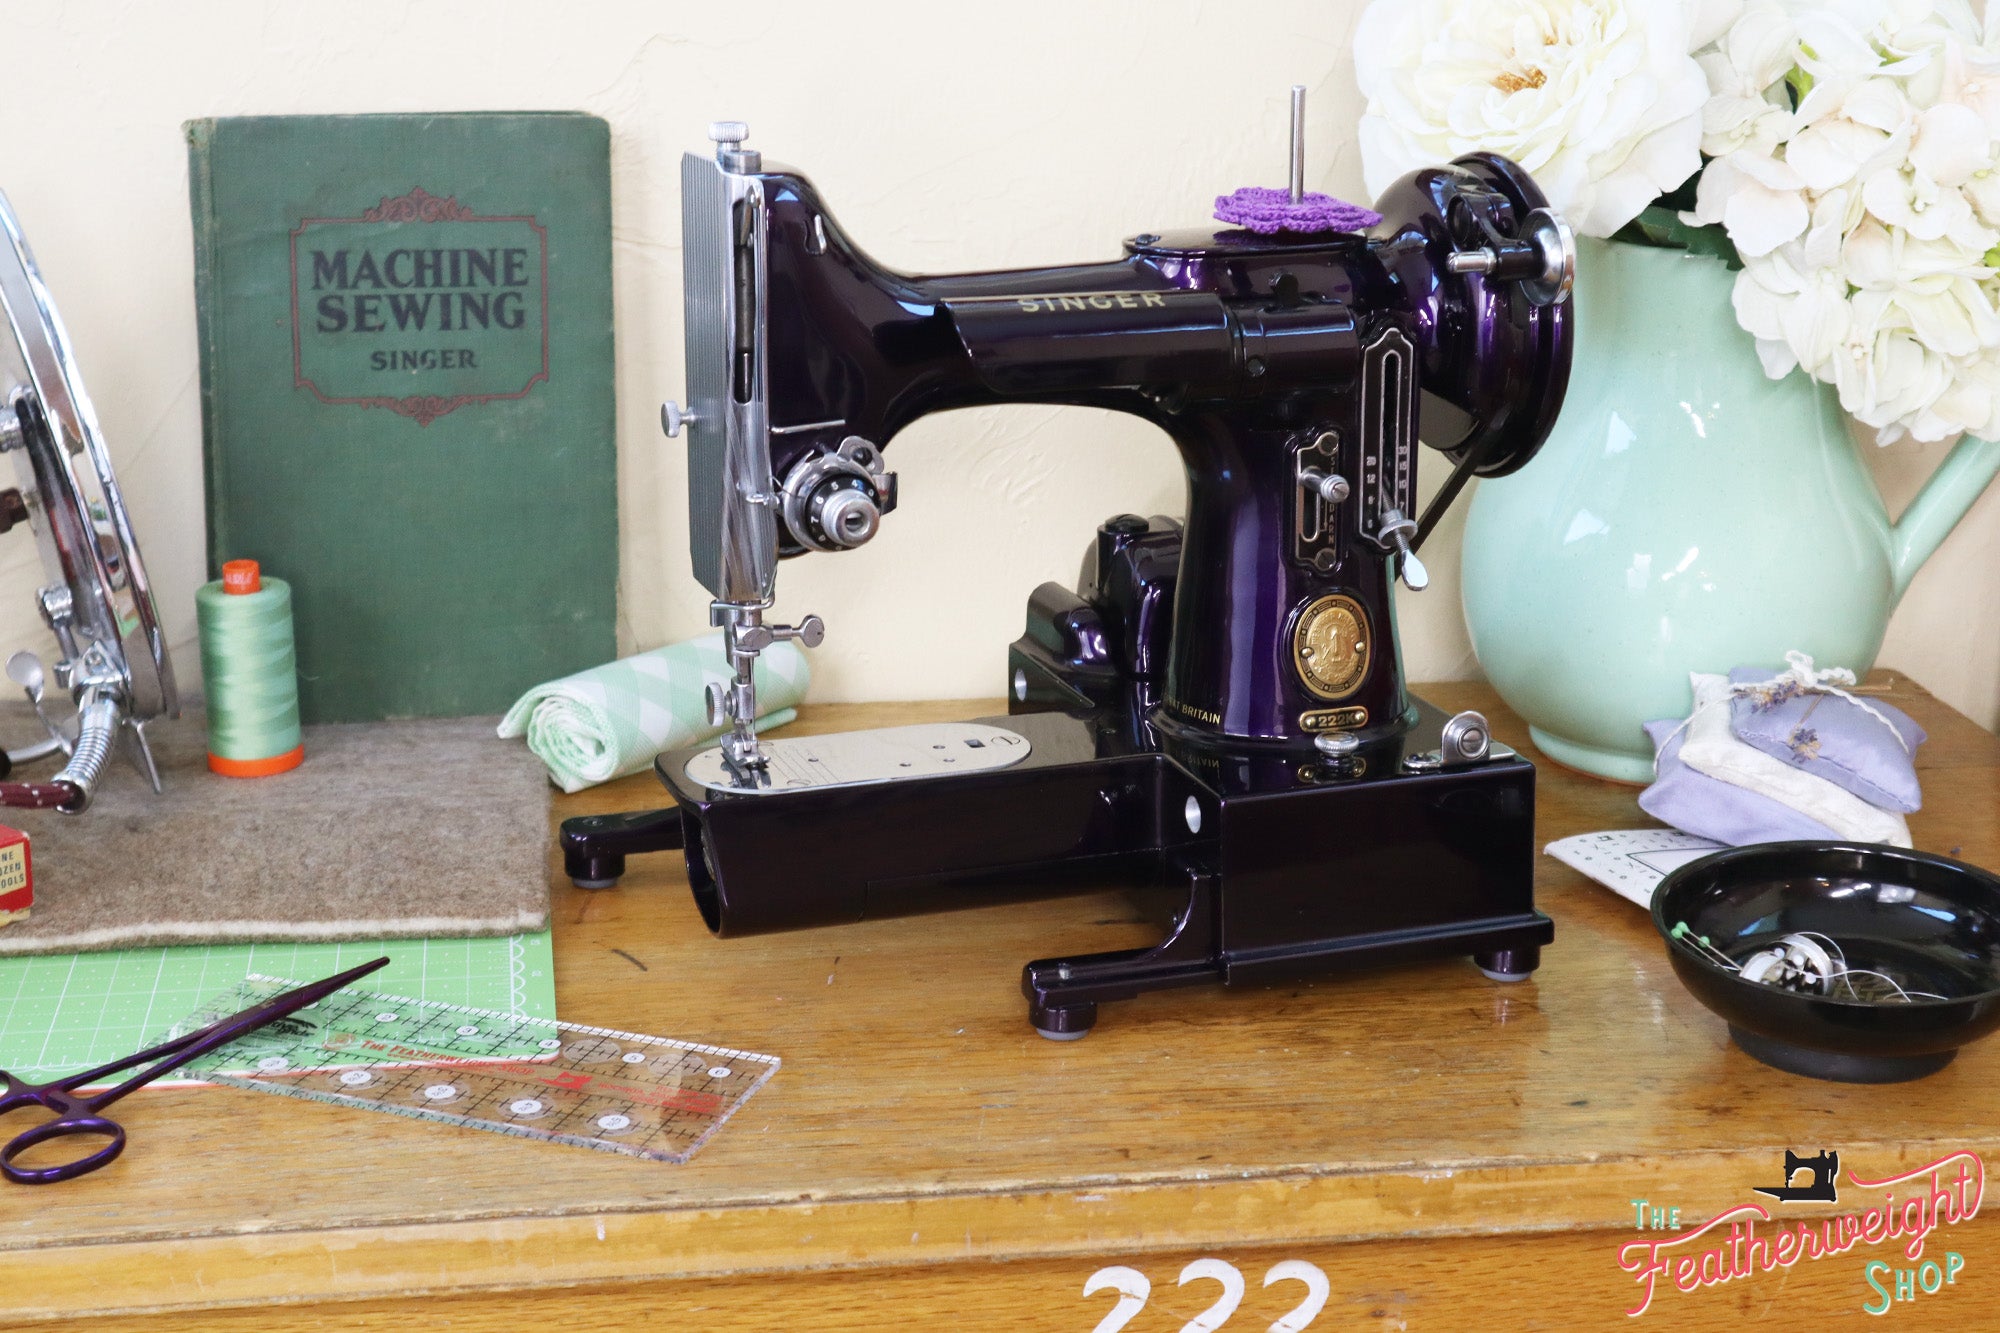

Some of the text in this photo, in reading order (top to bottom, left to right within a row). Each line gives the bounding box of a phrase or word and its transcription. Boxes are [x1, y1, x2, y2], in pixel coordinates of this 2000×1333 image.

[311, 248, 529, 290] MACHINE
[316, 291, 526, 333] SEWING
[1018, 293, 1166, 312] SINGER
[370, 349, 479, 371] SINGER
[1366, 473, 1376, 483] 12
[1182, 704, 1220, 724] BRITAIN
[1318, 713, 1355, 727] 222K
[361, 1040, 388, 1051] THE
